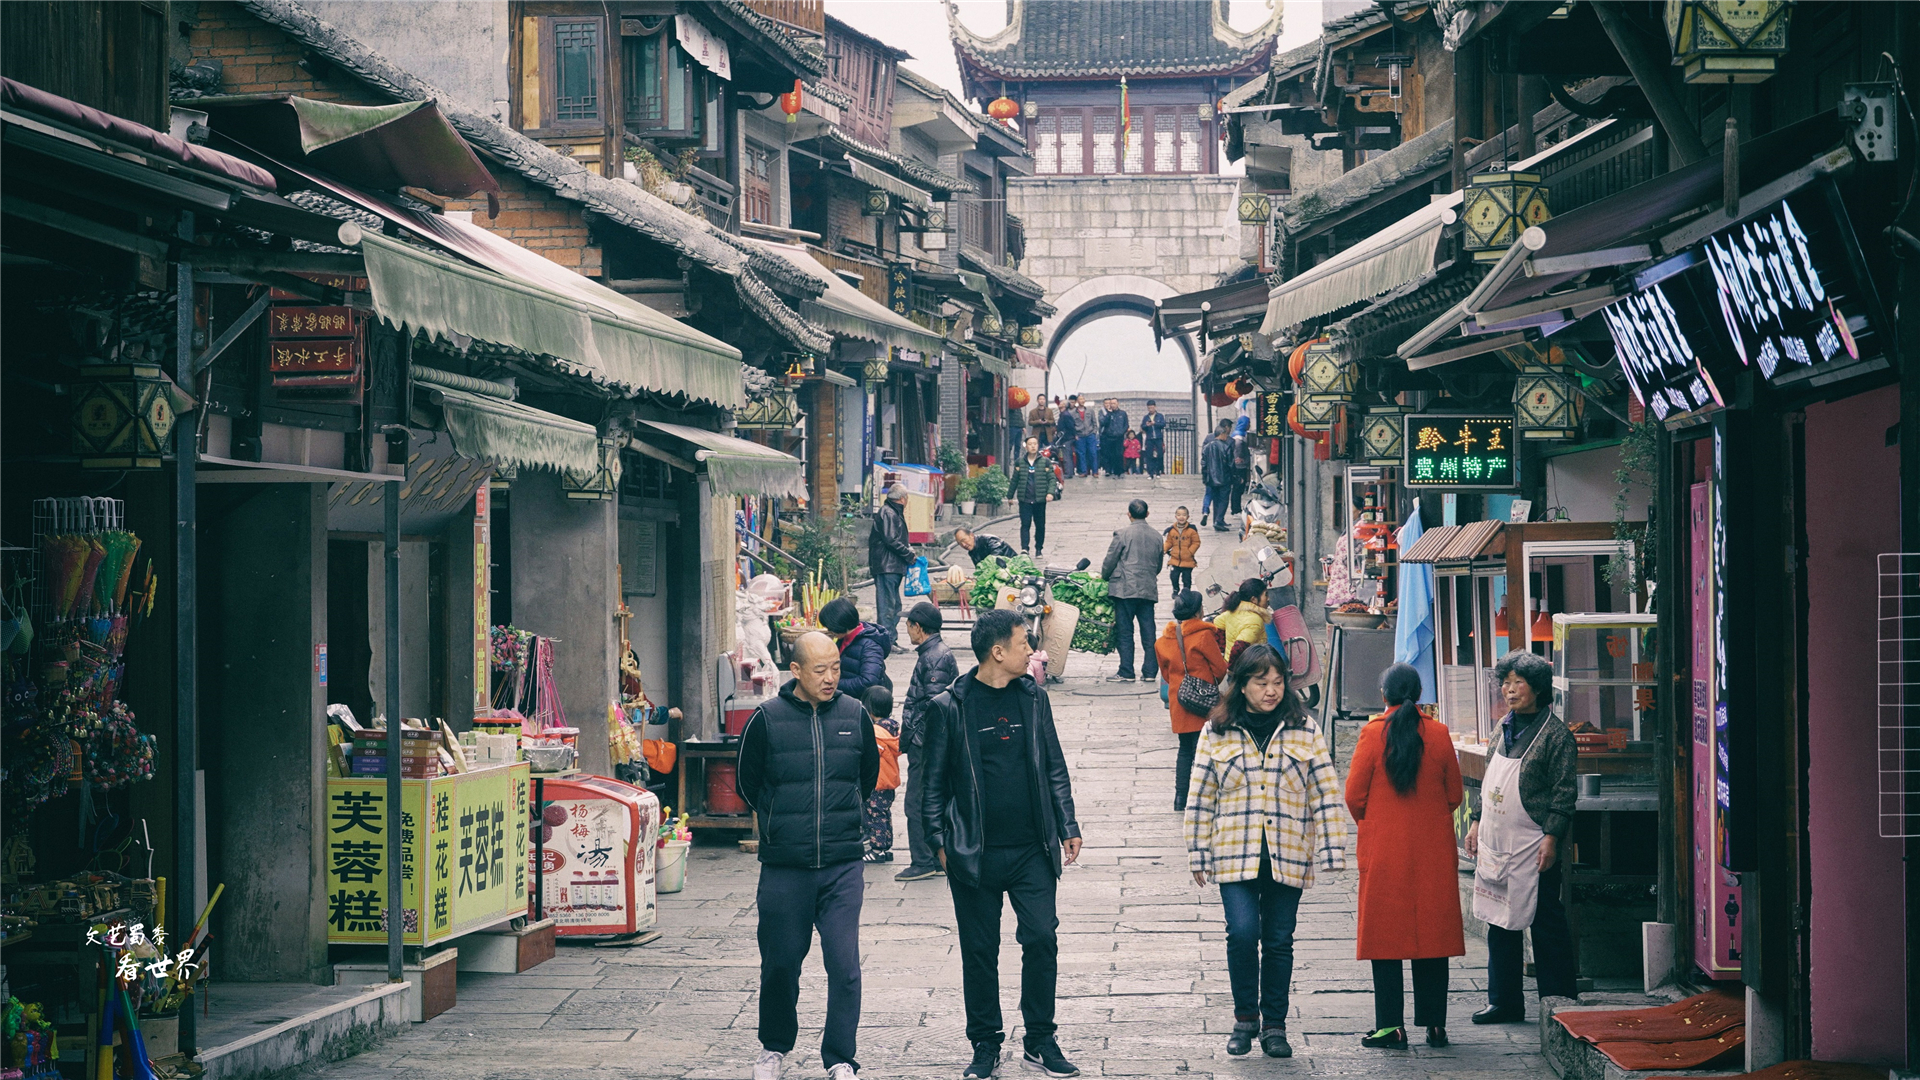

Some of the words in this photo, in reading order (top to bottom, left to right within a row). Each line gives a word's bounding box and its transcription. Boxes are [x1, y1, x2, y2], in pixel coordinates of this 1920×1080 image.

[893, 270, 907, 313] 冷饮站
[275, 311, 347, 333] 妈妈家常菜
[275, 345, 348, 367] 手工水饺
[1414, 423, 1505, 455] 黔牛王
[1413, 456, 1508, 480] 贵州特产
[434, 791, 450, 930] 桂花糕
[458, 799, 505, 898] 芙蓉糕
[516, 778, 526, 900] 桂花糕
[328, 790, 384, 932] 芙蓉糕
